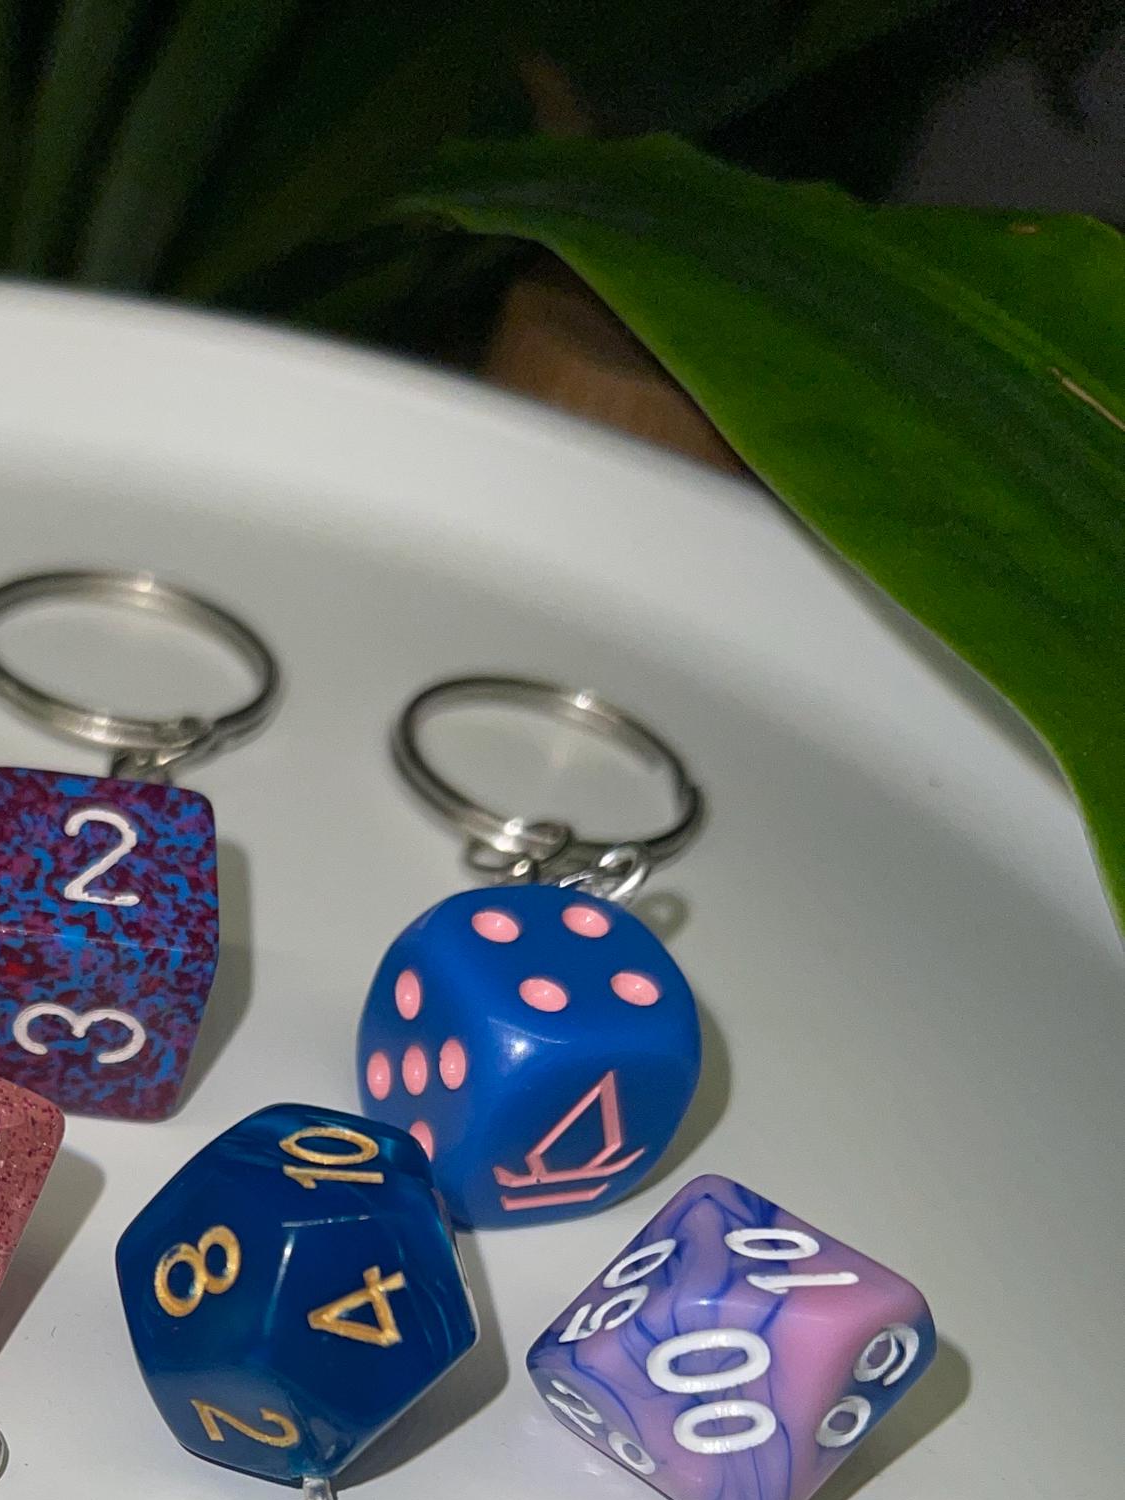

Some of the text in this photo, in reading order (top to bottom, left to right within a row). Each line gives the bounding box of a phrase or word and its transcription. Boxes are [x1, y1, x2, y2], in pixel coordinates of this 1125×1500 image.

[64, 809, 140, 907] 2
[13, 1003, 146, 1064] 3
[279, 1126, 384, 1189] 10
[154, 1225, 241, 1318] 8
[559, 1239, 677, 1344] 50
[724, 1228, 859, 1295] 10
[307, 1265, 406, 1348] 4
[191, 1399, 300, 1449] 2
[646, 1328, 776, 1454] 00
